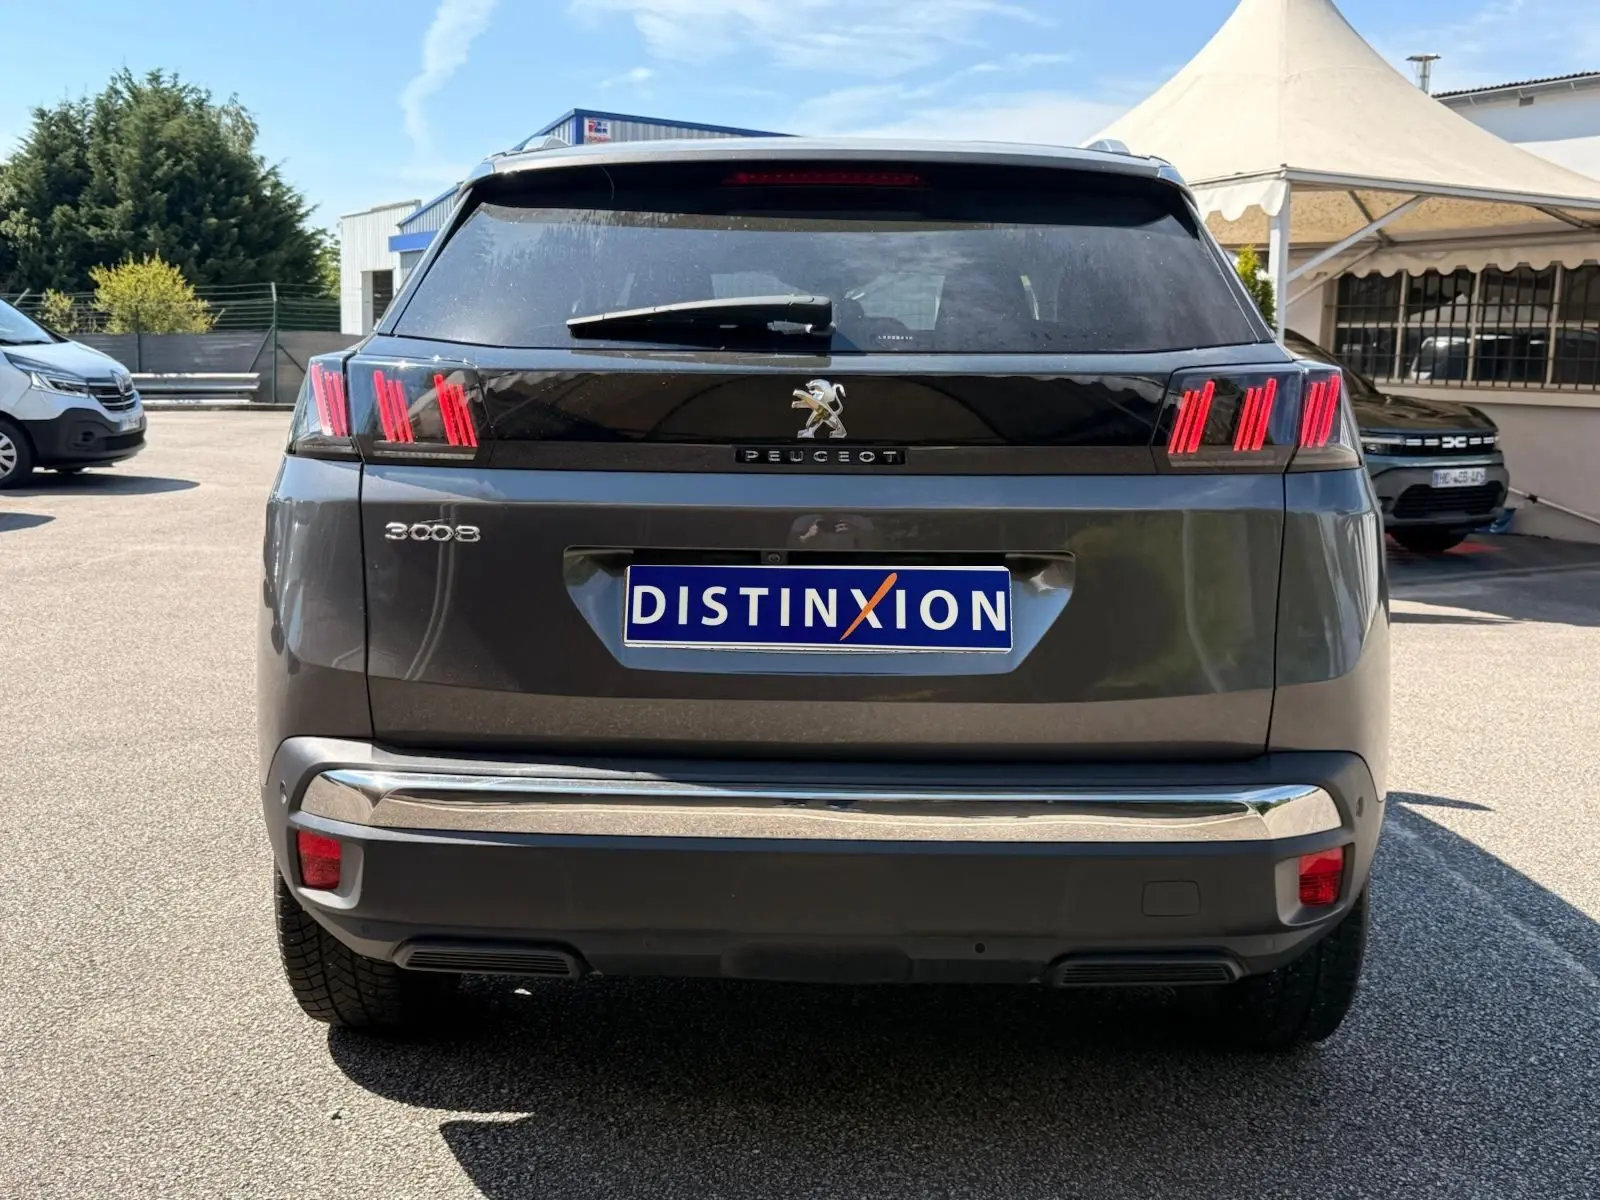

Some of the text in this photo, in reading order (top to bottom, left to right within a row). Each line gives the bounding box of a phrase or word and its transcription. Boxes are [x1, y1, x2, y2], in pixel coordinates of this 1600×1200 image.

[745, 450, 897, 463] PEUGEOT
[384, 521, 481, 542] 3008
[631, 572, 1007, 641] DISTINXION
